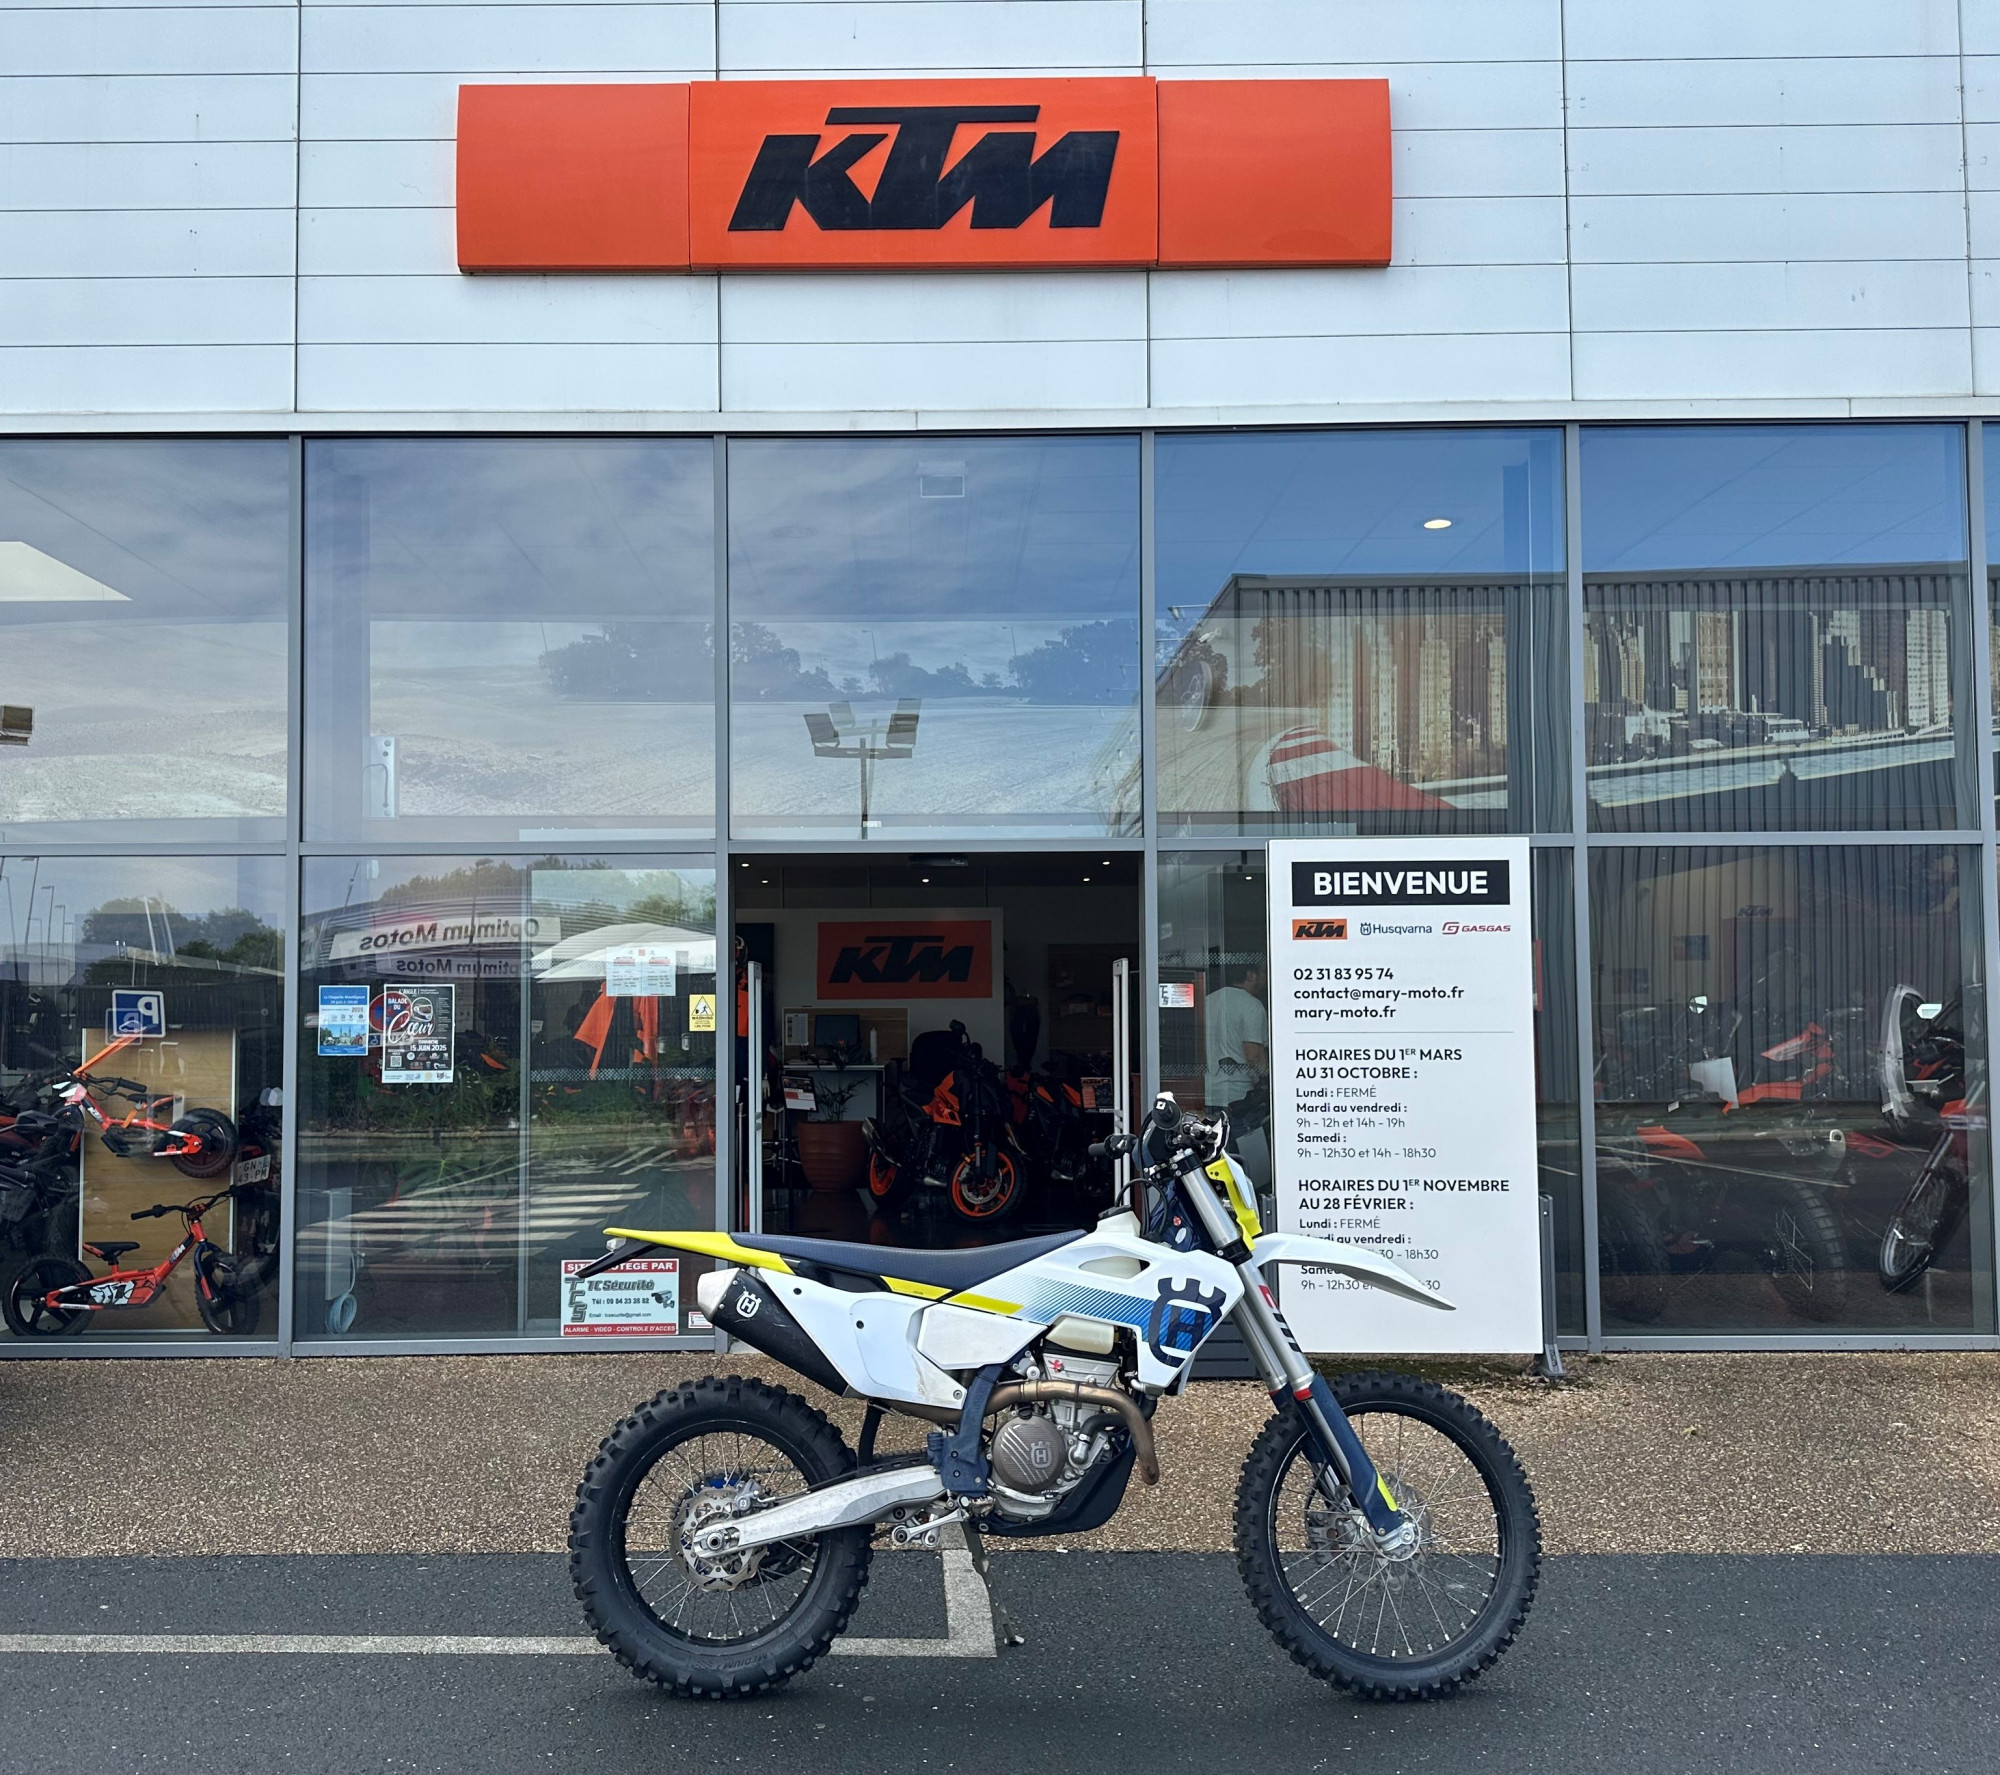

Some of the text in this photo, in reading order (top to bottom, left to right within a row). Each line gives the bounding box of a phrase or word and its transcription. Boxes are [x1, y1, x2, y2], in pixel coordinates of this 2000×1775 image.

[728, 106, 1119, 230] KTM
[1314, 871, 1488, 896] BIENVENUE
[1295, 922, 1344, 938] KTM
[1373, 924, 1432, 935] Husqvarna
[829, 936, 974, 983] KTM
[1294, 968, 1393, 980] 02 31 83 95 74
[1294, 986, 1464, 1001] contact@mary-moto.fr
[1295, 1006, 1396, 1021] mary-moto.fr
[1296, 1049, 1370, 1060] HORAIRES
[1375, 1049, 1395, 1060] DU
[1420, 1049, 1462, 1060] MARS
[1296, 1068, 1316, 1078] AU
[1321, 1068, 1333, 1078] 31
[1337, 1067, 1410, 1078] OCTOBRE
[1296, 1088, 1327, 1097] Lundi
[1337, 1085, 1376, 1097] FERMÉ
[1297, 1103, 1330, 1112] Mardi
[1350, 1103, 1401, 1112] vendredi
[1297, 1118, 1310, 1127] 9h
[1322, 1118, 1339, 1127] 12h
[1343, 1118, 1354, 1127] et
[1357, 1118, 1375, 1127] 14h
[1387, 1118, 1405, 1127] 19h
[1297, 1133, 1340, 1142] Samedi
[1298, 1148, 1311, 1157] 9h
[1322, 1148, 1355, 1158] 12h30
[1359, 1149, 1369, 1158] et
[1373, 1148, 1391, 1157] 14h
[1403, 1148, 1436, 1158] 18h30
[1299, 1180, 1374, 1191] HORAIRES
[1378, 1180, 1399, 1191] DU
[1424, 1180, 1509, 1191] NOVEMBRE
[1299, 1198, 1319, 1209] AU
[1324, 1198, 1340, 1209] 28
[1344, 1194, 1406, 1209] FÉVRIER
[1300, 1219, 1331, 1228] Lundi
[1340, 1216, 1380, 1228] FERMÉ
[1337, 1235, 1350, 1244] au
[1354, 1234, 1404, 1243] vendredi
[1405, 1250, 1438, 1259] 18h30
[1301, 1280, 1315, 1289] 9h
[1327, 1279, 1360, 1290] 12h30
